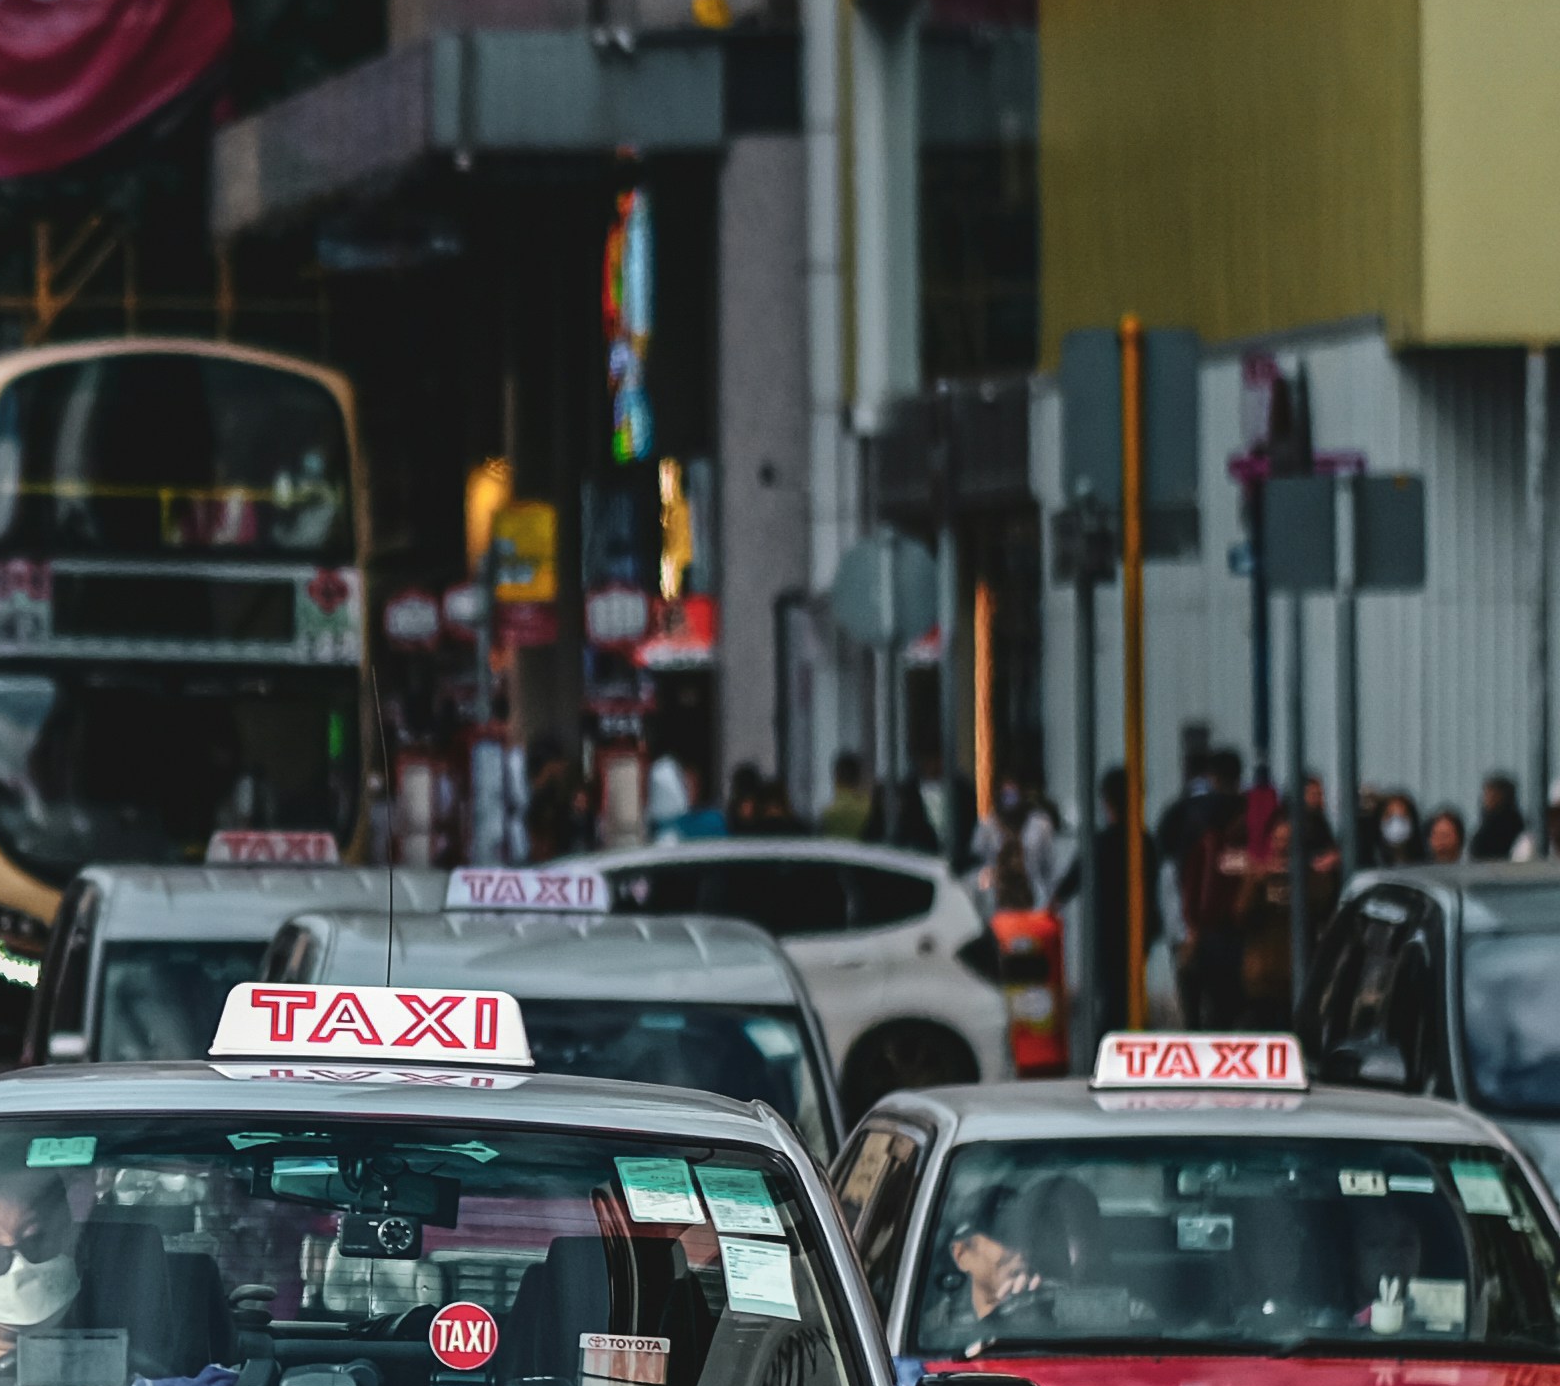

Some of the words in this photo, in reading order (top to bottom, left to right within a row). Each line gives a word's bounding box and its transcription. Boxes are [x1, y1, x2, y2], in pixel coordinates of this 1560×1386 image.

[221, 835, 327, 862] TAXI
[462, 873, 594, 905] TAXI
[251, 989, 498, 1050] TAXI
[1116, 1041, 1288, 1079] TAXI
[436, 1320, 491, 1353] TAXI
[609, 1339, 662, 1351] TOYOTA
